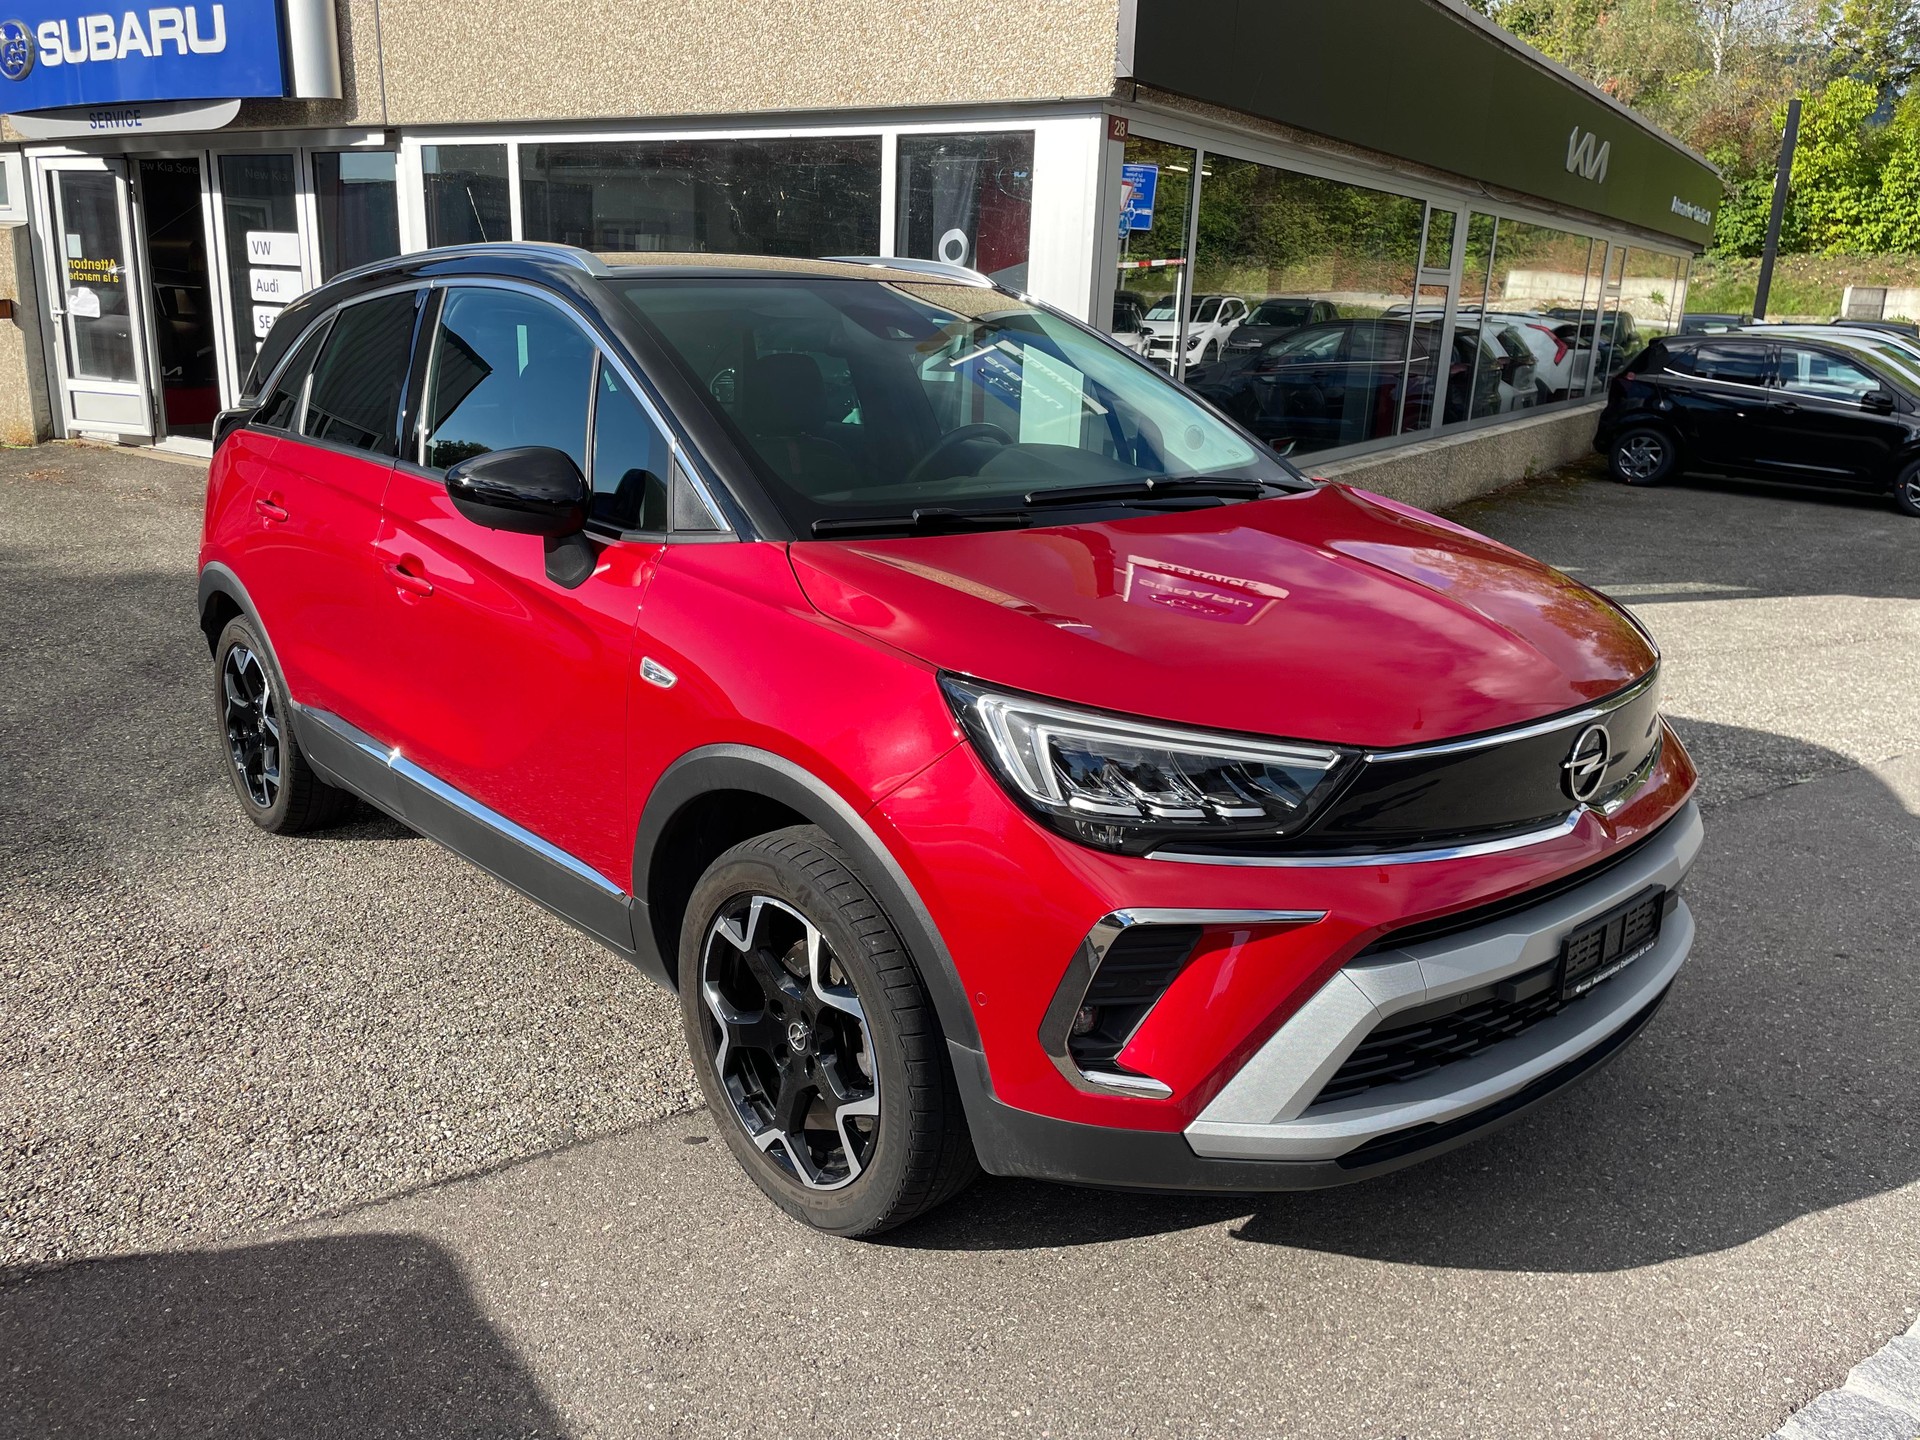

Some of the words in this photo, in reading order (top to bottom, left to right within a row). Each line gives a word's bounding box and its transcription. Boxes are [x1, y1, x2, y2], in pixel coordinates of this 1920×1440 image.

[37, 4, 227, 67] SUBARU
[89, 109, 142, 130] SERVICE
[1114, 120, 1126, 137] 28
[141, 162, 155, 171] ew
[157, 161, 173, 172] Kia
[176, 163, 199, 175] Sore
[244, 168, 269, 181] New
[271, 171, 288, 183] Kia
[252, 241, 271, 256] VW
[256, 278, 279, 293] Audi
[259, 315, 278, 329] SE
